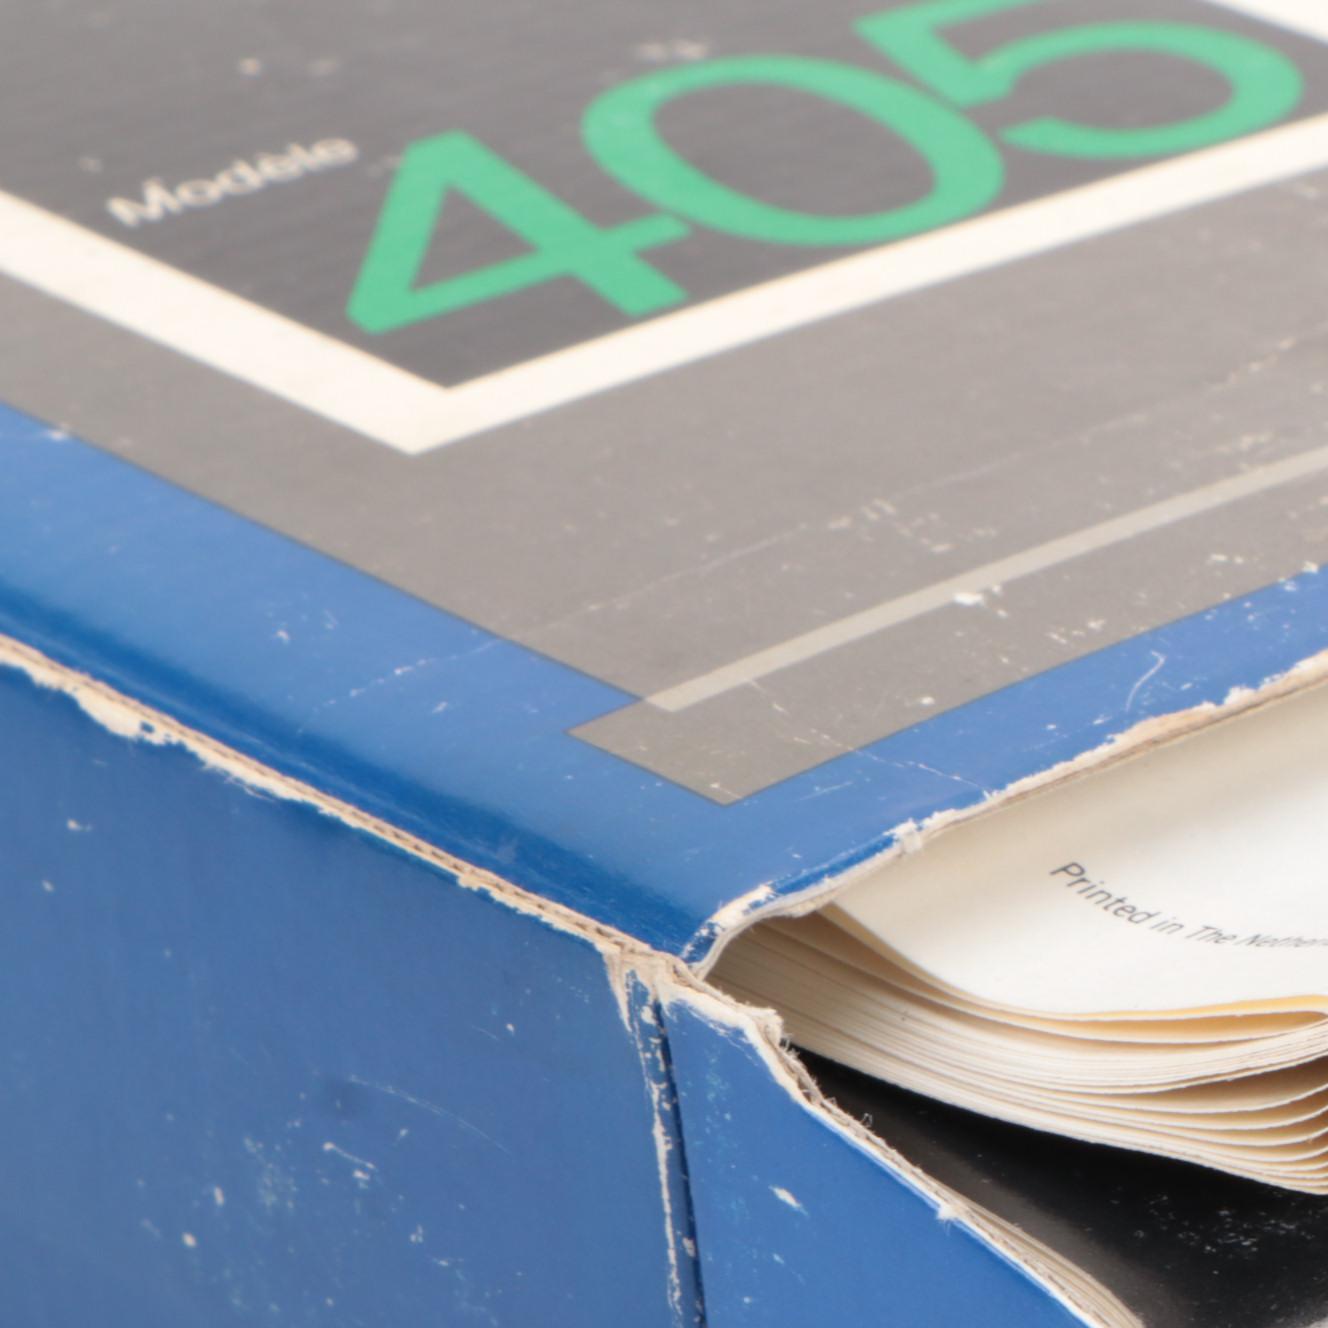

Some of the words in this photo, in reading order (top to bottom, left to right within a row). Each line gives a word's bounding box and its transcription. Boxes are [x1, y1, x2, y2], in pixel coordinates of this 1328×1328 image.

[346, 0, 1303, 333] 405
[1050, 861, 1154, 924] Printed
[1150, 915, 1185, 935] in
[1185, 924, 1237, 946] The
